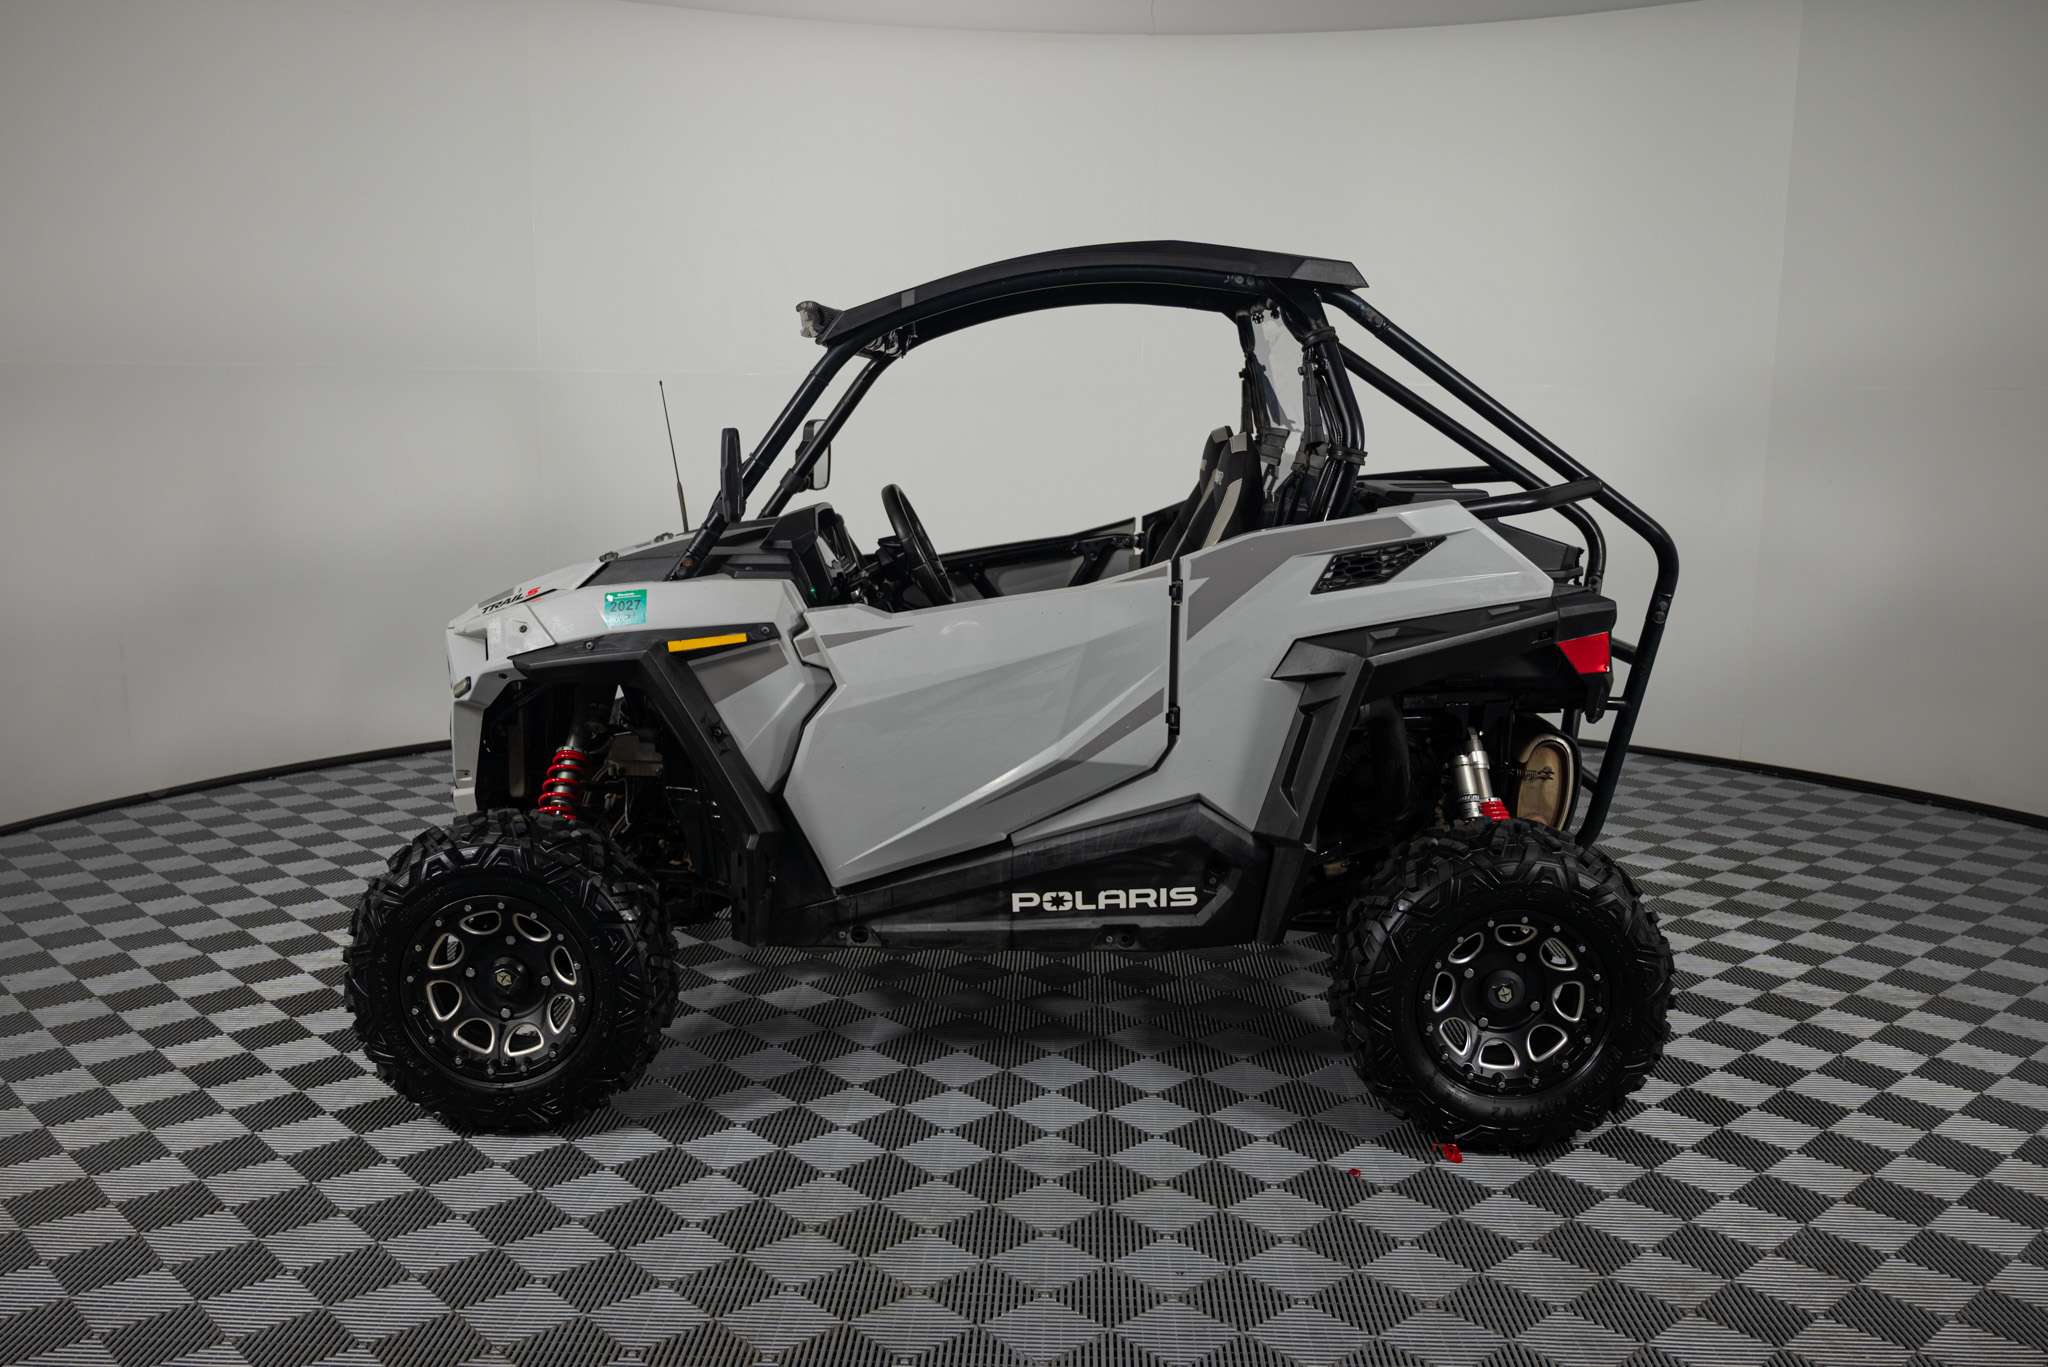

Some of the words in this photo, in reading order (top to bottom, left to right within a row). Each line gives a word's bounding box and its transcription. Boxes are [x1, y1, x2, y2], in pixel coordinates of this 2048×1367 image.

[481, 594, 525, 614] TRAIL
[525, 586, 542, 598] S
[610, 599, 641, 612] 2027
[1011, 886, 1198, 913] POLARIS
